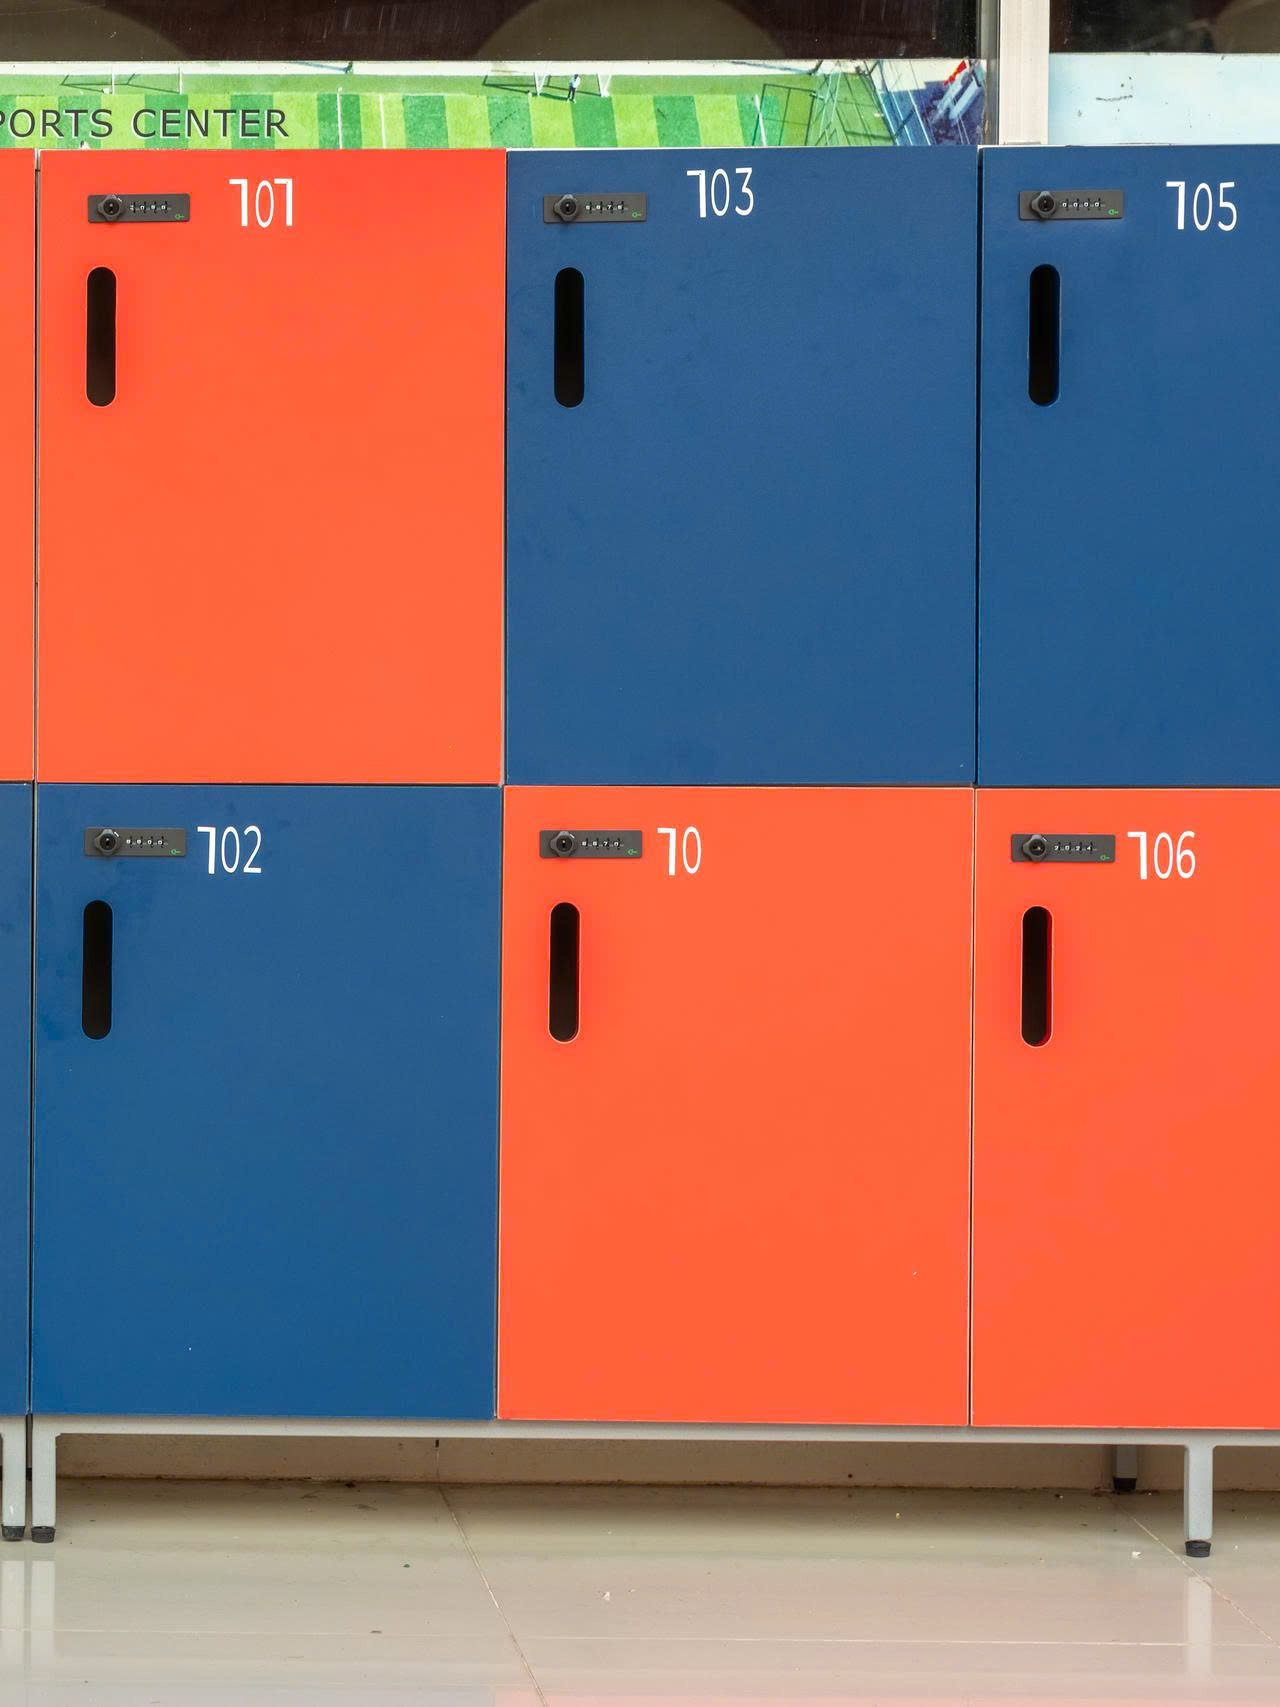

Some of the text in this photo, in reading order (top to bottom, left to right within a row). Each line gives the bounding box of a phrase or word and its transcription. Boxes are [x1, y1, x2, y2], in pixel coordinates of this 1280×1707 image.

[133, 109, 289, 138] CENTER
[229, 178, 293, 228] 101
[686, 167, 754, 218] 103
[1166, 181, 1237, 232] 105
[197, 825, 262, 875] 102
[657, 826, 702, 876] 10
[1127, 830, 1196, 880] 106
